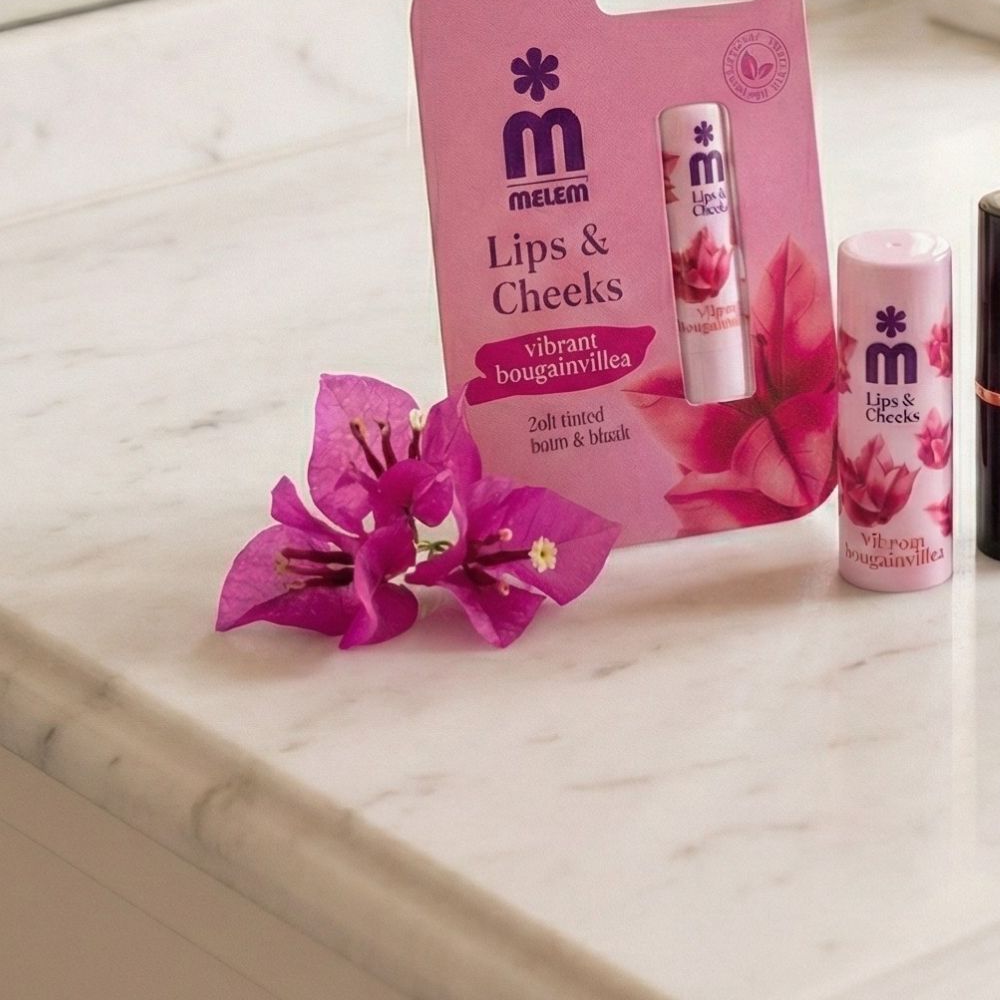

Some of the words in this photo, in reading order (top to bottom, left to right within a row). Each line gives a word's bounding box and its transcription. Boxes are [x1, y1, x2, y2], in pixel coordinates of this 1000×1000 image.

[508, 183, 590, 211] MELEM
[487, 232, 567, 274] Lips
[581, 223, 609, 257] &
[492, 270, 624, 316] Cheeks
[524, 332, 599, 358] vibrant
[495, 350, 633, 385] bougainvillea
[866, 391, 899, 412] Lips
[902, 392, 916, 408] &
[865, 407, 920, 424] Cheeks
[573, 431, 585, 449] &
